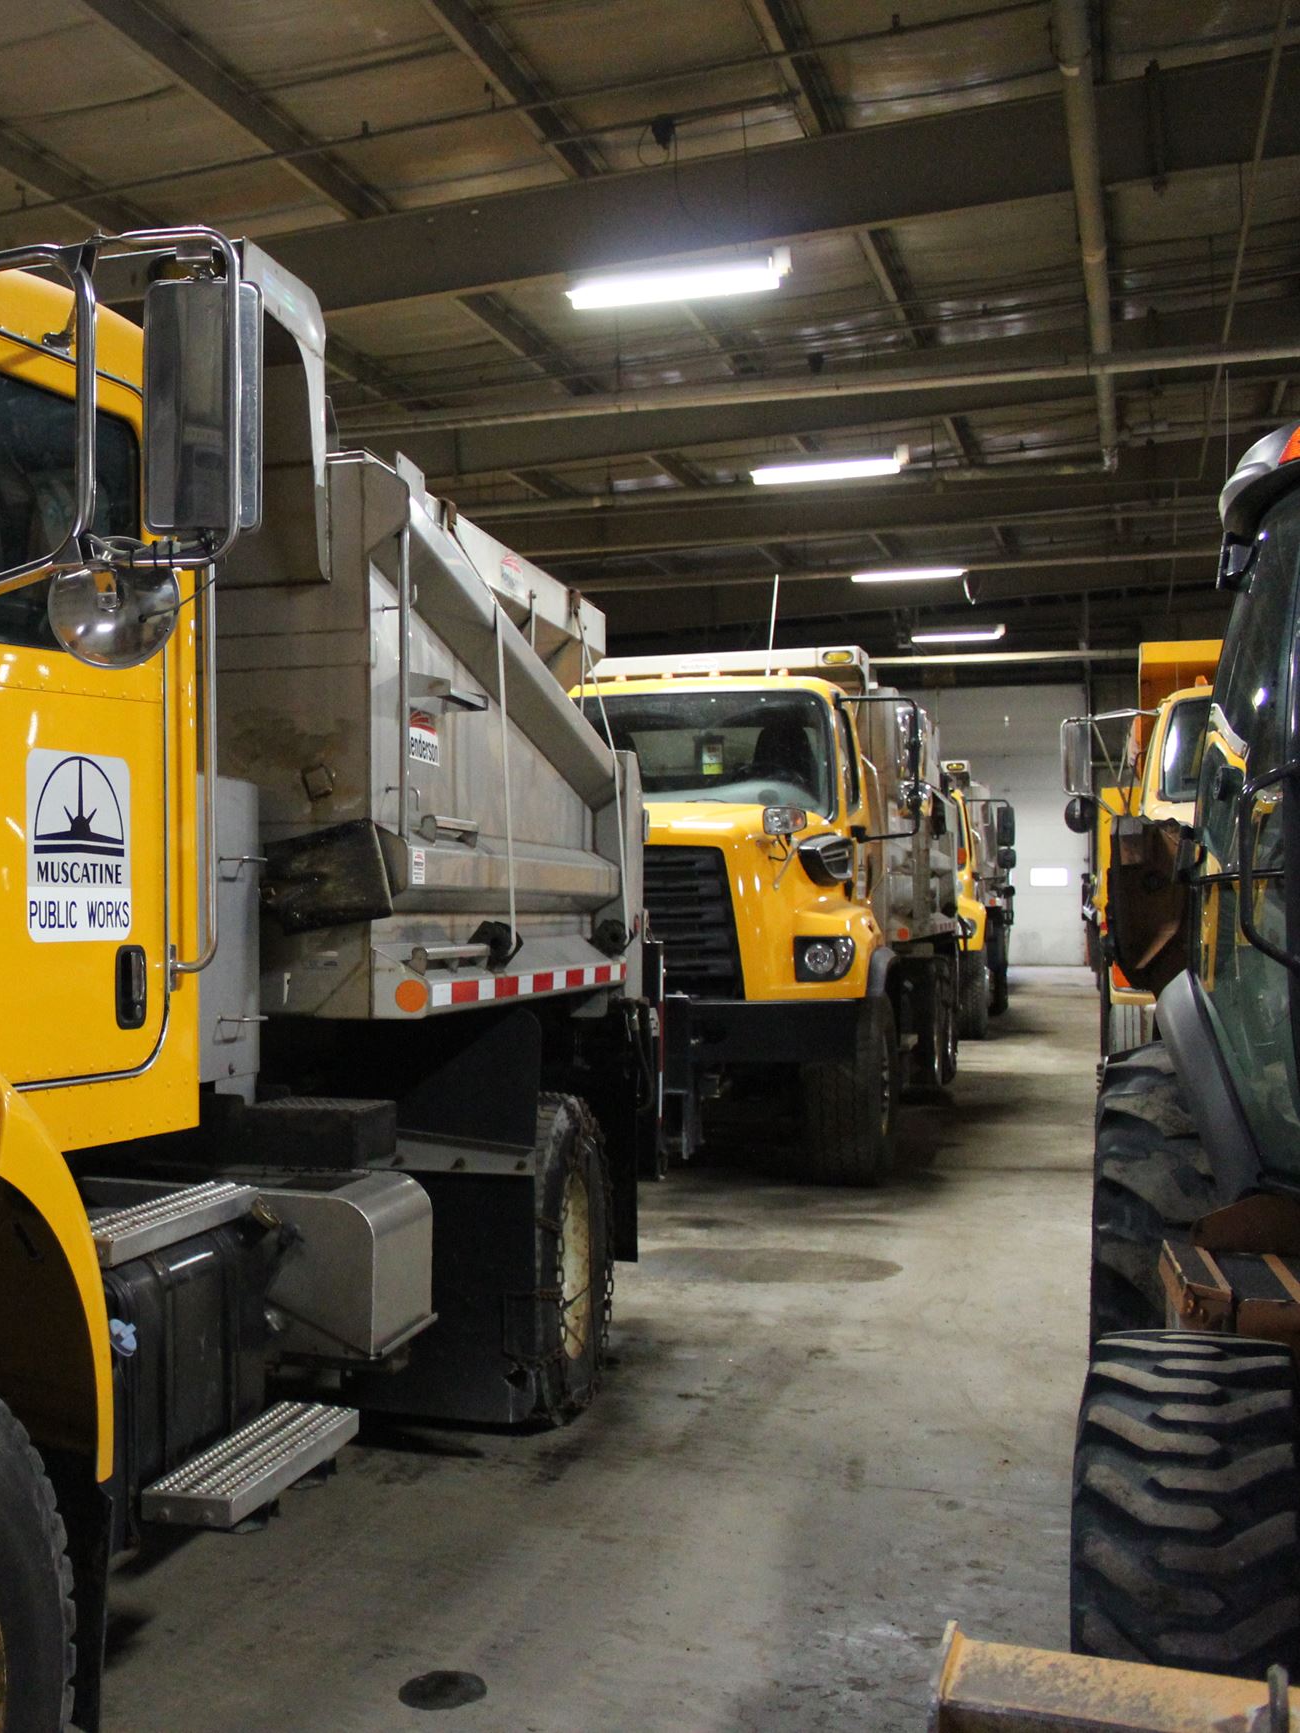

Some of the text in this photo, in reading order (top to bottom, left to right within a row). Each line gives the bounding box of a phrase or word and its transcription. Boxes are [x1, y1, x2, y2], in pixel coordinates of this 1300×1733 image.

[409, 733, 438, 763] enderson
[37, 861, 122, 885] MUSCATINE
[29, 900, 130, 928] PUBLIC WORKS
